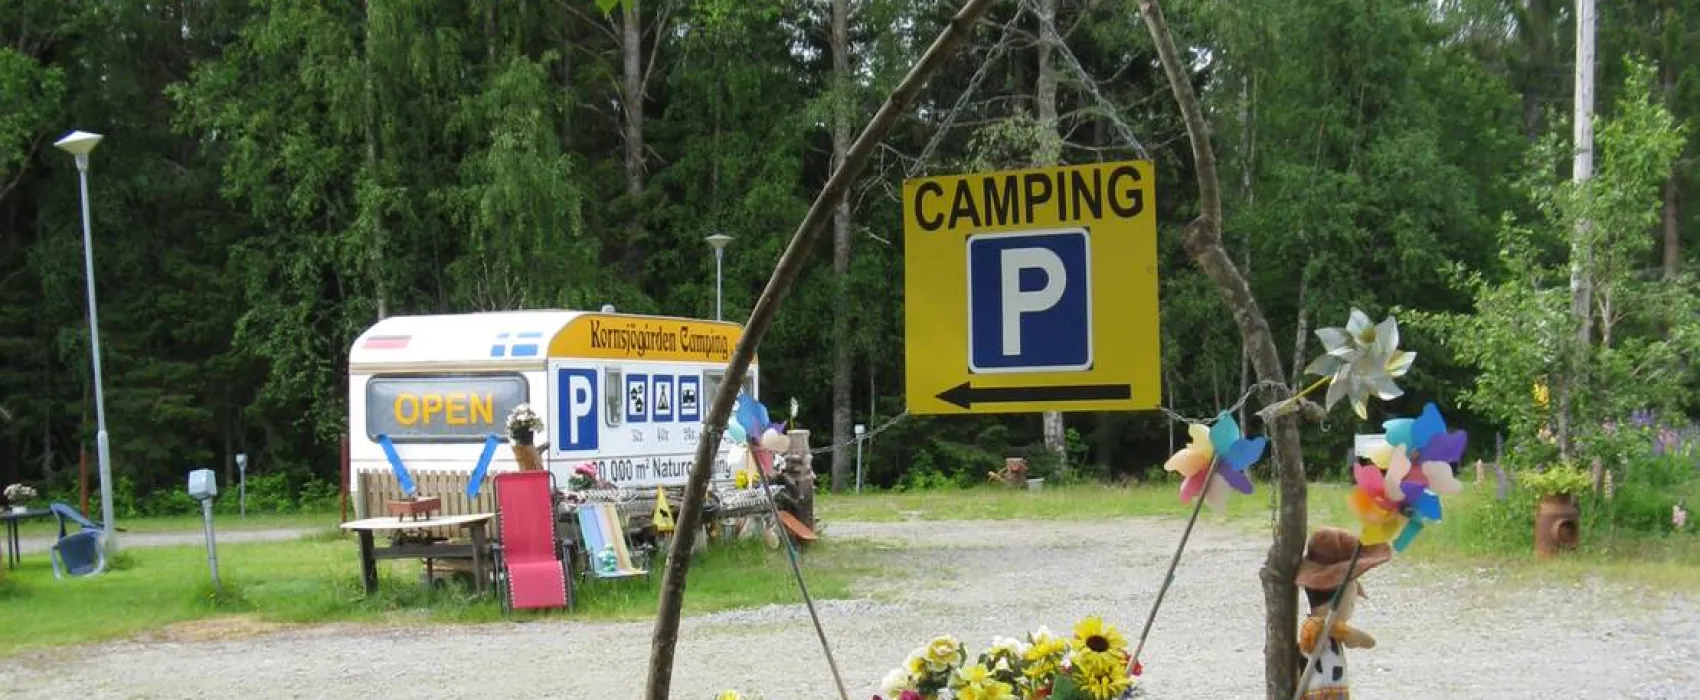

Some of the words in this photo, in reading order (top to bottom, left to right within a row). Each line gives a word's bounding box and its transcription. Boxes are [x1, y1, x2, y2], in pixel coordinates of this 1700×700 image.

[914, 166, 1144, 231] CAMPING
[1001, 247, 1067, 356] P
[590, 320, 676, 357] Kornsjögården
[680, 326, 728, 360] Camping
[393, 391, 494, 426] OPEN
[568, 375, 592, 445] P
